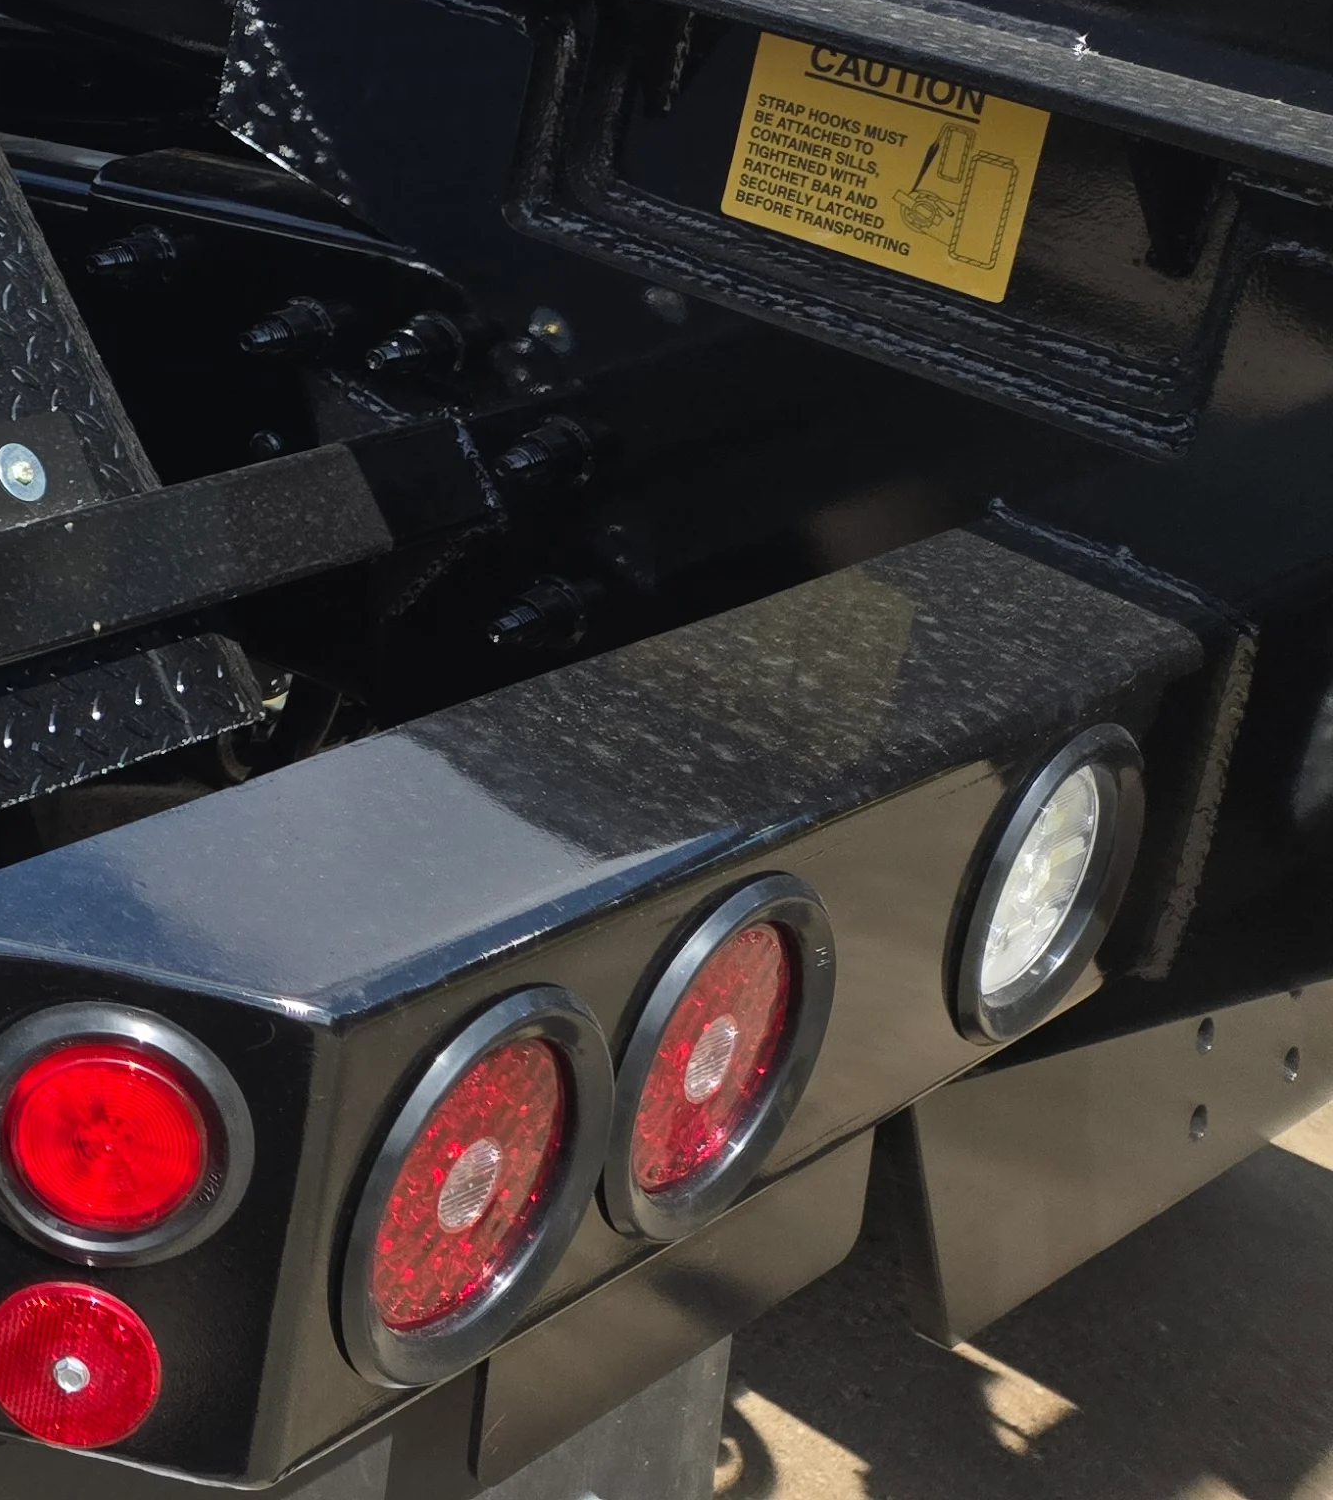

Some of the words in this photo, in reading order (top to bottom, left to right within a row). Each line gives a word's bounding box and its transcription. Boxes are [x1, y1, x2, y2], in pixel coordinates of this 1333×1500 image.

[810, 45, 987, 115] CAUTION
[754, 110, 775, 126] BE
[776, 117, 852, 149] ATTACHED
[854, 138, 874, 155] TO
[758, 93, 805, 117] STRAP
[808, 108, 861, 134] HOOKS
[864, 124, 909, 148] MUST
[747, 141, 828, 177] TIGHTENED
[830, 166, 868, 189] WITH
[750, 126, 833, 161] CONTAINER
[834, 151, 880, 179] SILLS,
[739, 173, 814, 207] SECURELY
[816, 197, 885, 230] LATCHED
[742, 157, 810, 188] RATCHET
[811, 179, 843, 199] BAR
[844, 190, 878, 210] AND
[735, 189, 794, 219] BEFORE
[795, 207, 911, 257] TRANSPORTING
